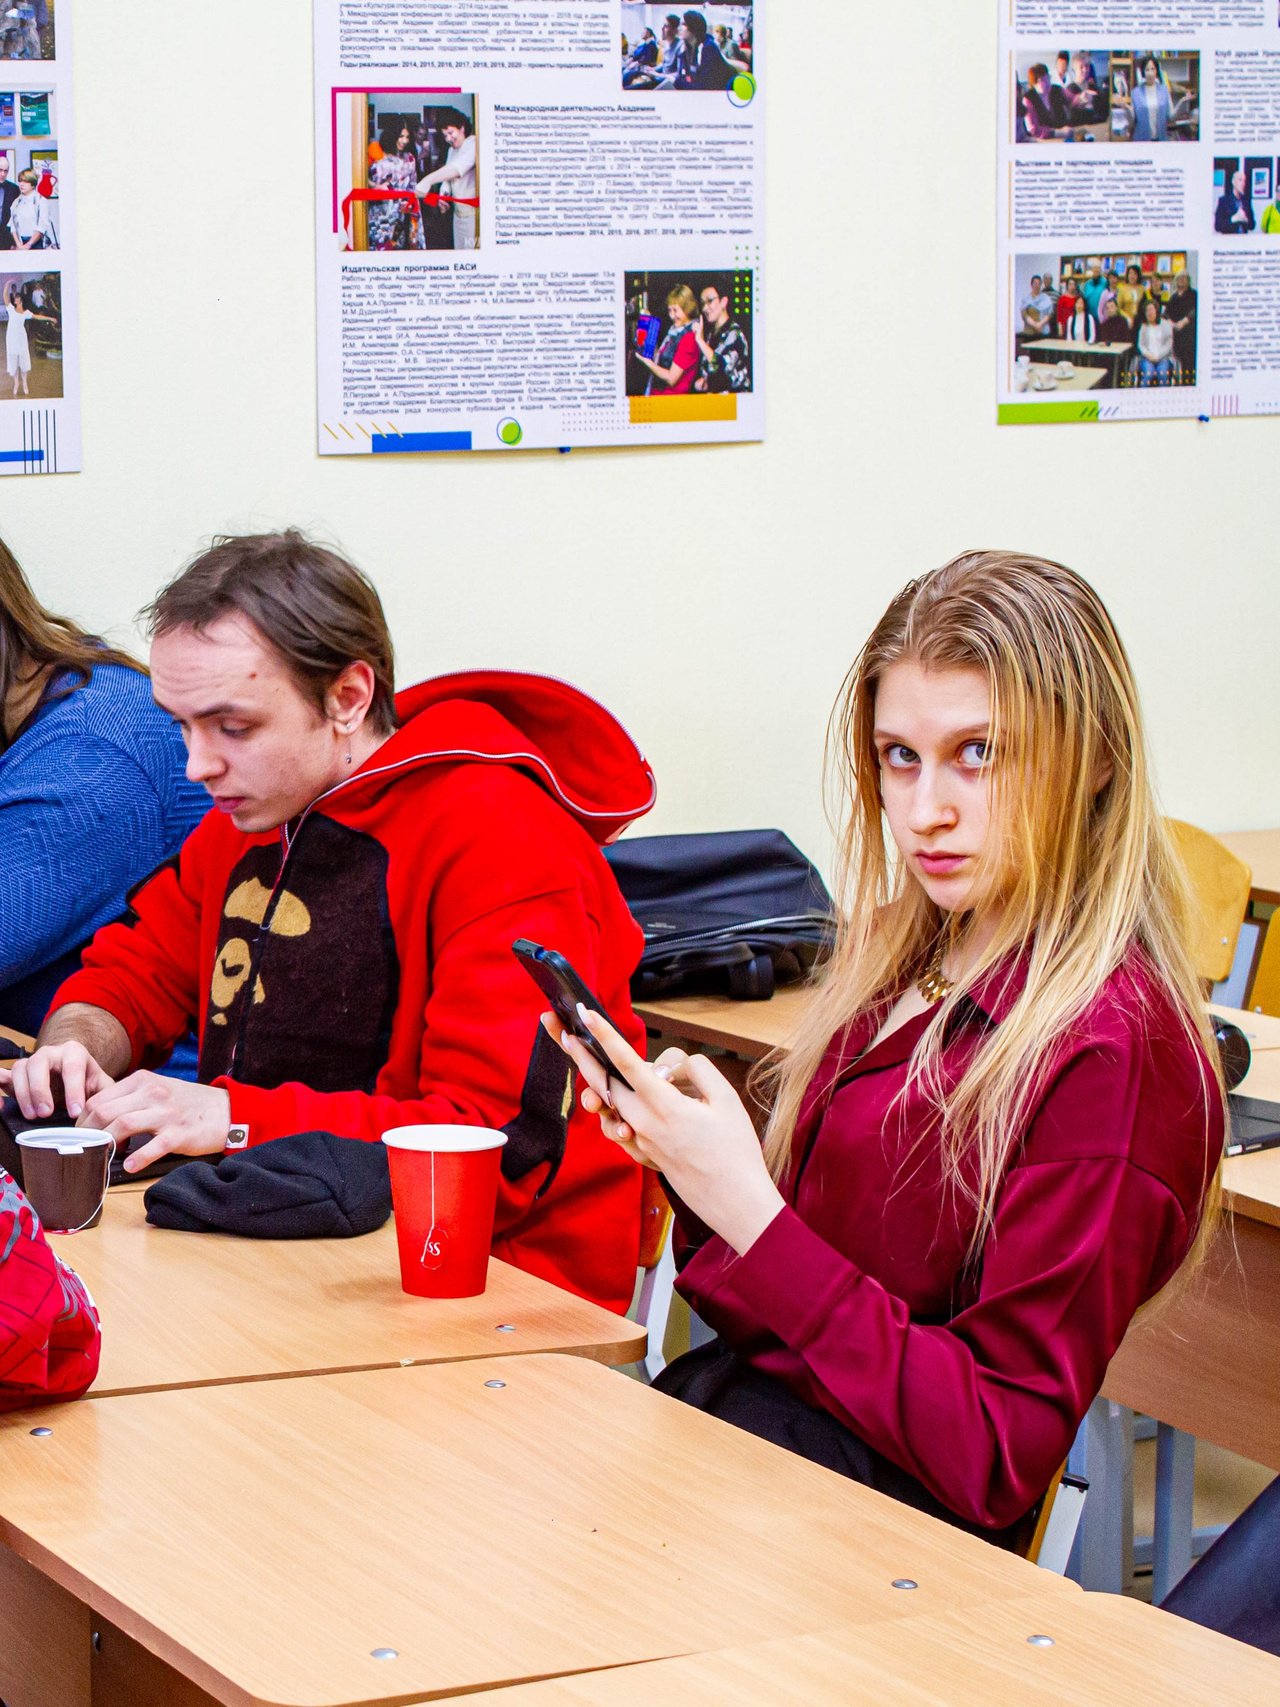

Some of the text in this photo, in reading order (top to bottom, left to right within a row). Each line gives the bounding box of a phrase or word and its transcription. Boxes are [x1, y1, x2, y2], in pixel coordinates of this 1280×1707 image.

[341, 262, 477, 274] Издательская программа ЕАСИ
